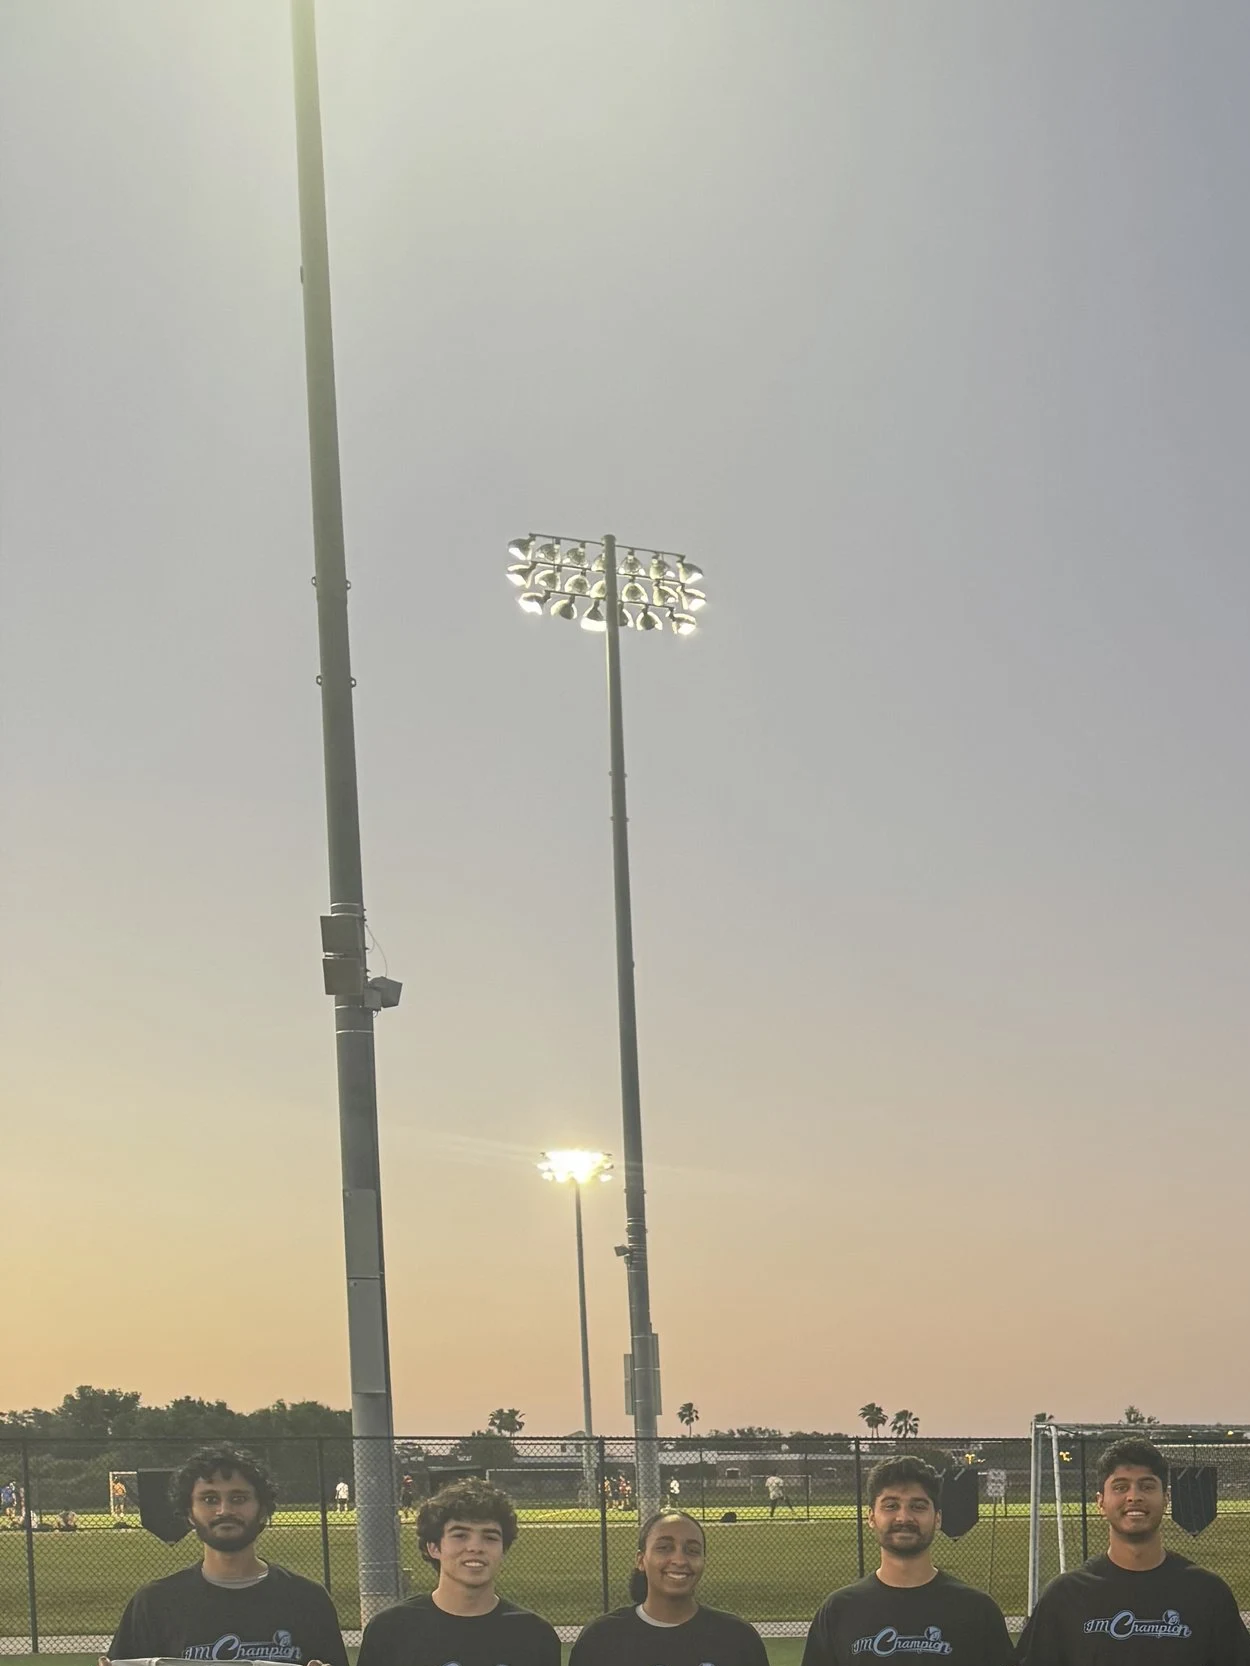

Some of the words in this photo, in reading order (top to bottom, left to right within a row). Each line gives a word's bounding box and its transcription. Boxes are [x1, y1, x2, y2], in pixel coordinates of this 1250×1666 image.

[1110, 1611, 1192, 1638] Champion
[212, 1635, 301, 1660] Champion
[873, 1627, 952, 1655] Champion
